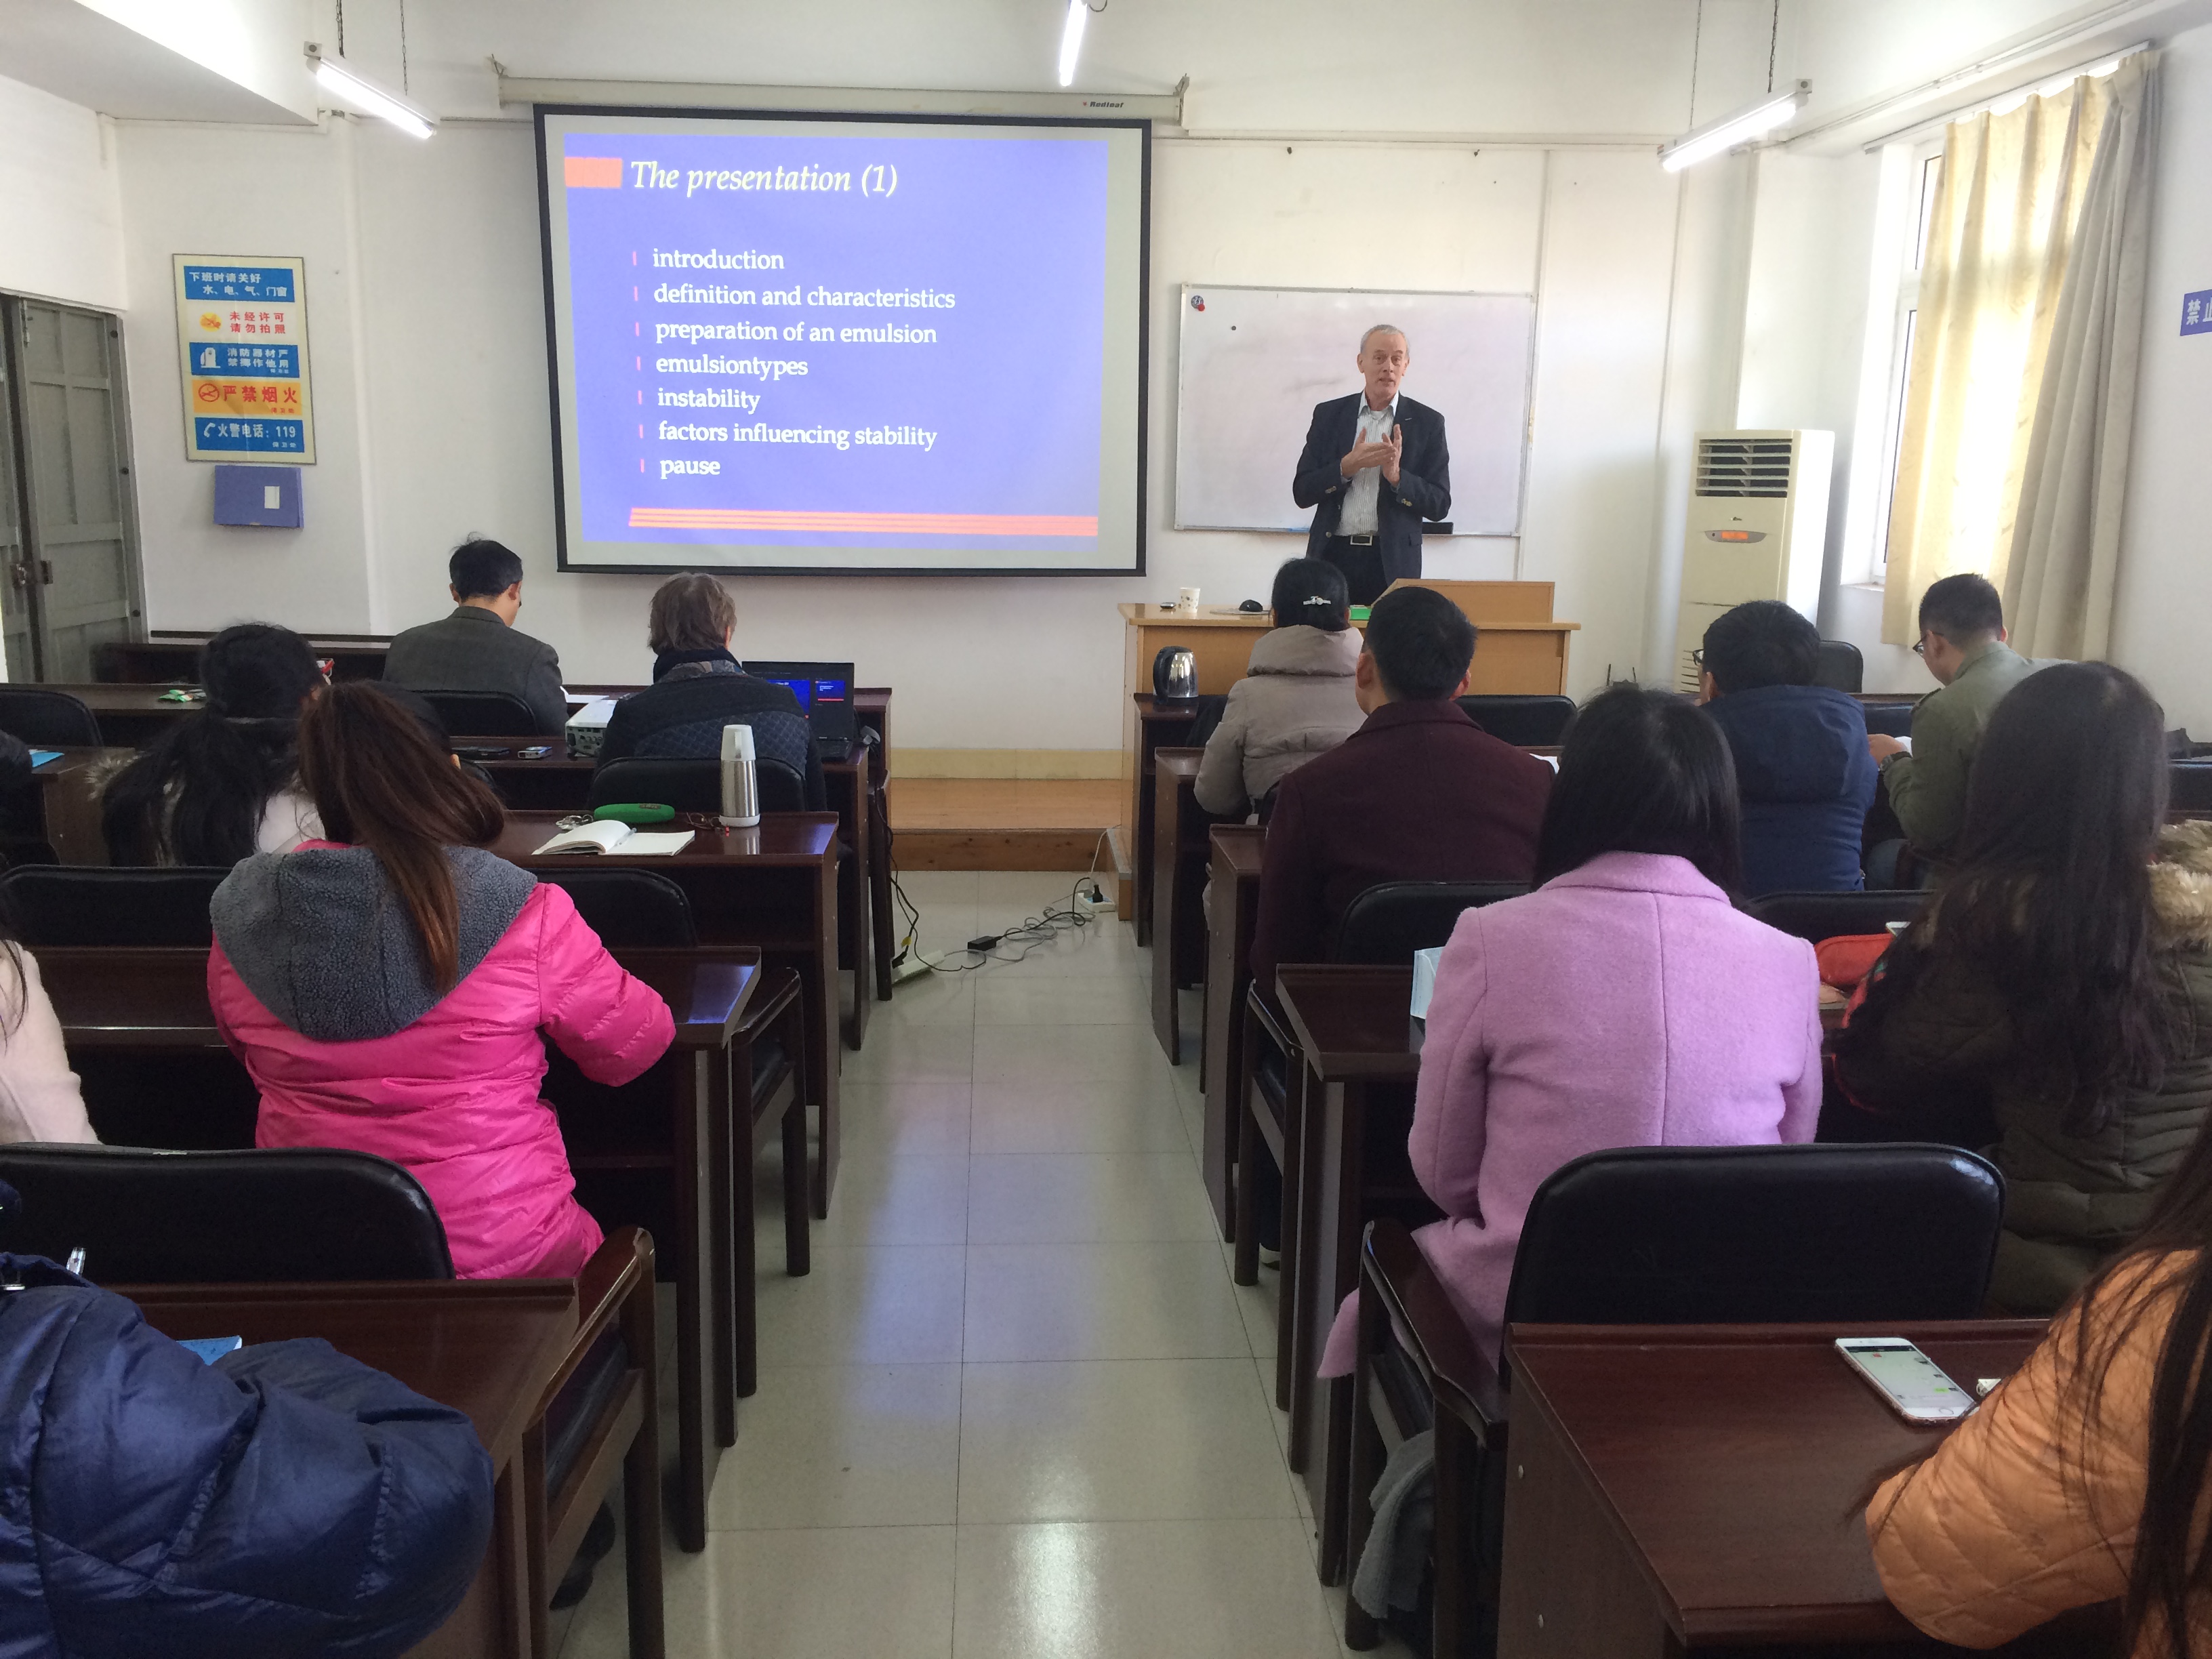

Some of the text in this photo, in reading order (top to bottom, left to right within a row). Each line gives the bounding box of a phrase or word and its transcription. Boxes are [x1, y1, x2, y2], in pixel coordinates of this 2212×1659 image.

[631, 161, 897, 197] The presentation (1)
[653, 249, 784, 269] introduction
[189, 272, 261, 283] 下班时请关好
[654, 283, 955, 308] definition and characteristics
[230, 311, 284, 322] 未经许可
[230, 323, 285, 334] 请勿拍照
[655, 321, 937, 344] preparation of an emulsion
[657, 354, 808, 381] emulsiontypes
[223, 385, 298, 403] 严禁烟火
[658, 388, 760, 414] instability
[659, 421, 937, 451] factors influencing stability
[660, 460, 720, 479] pause
